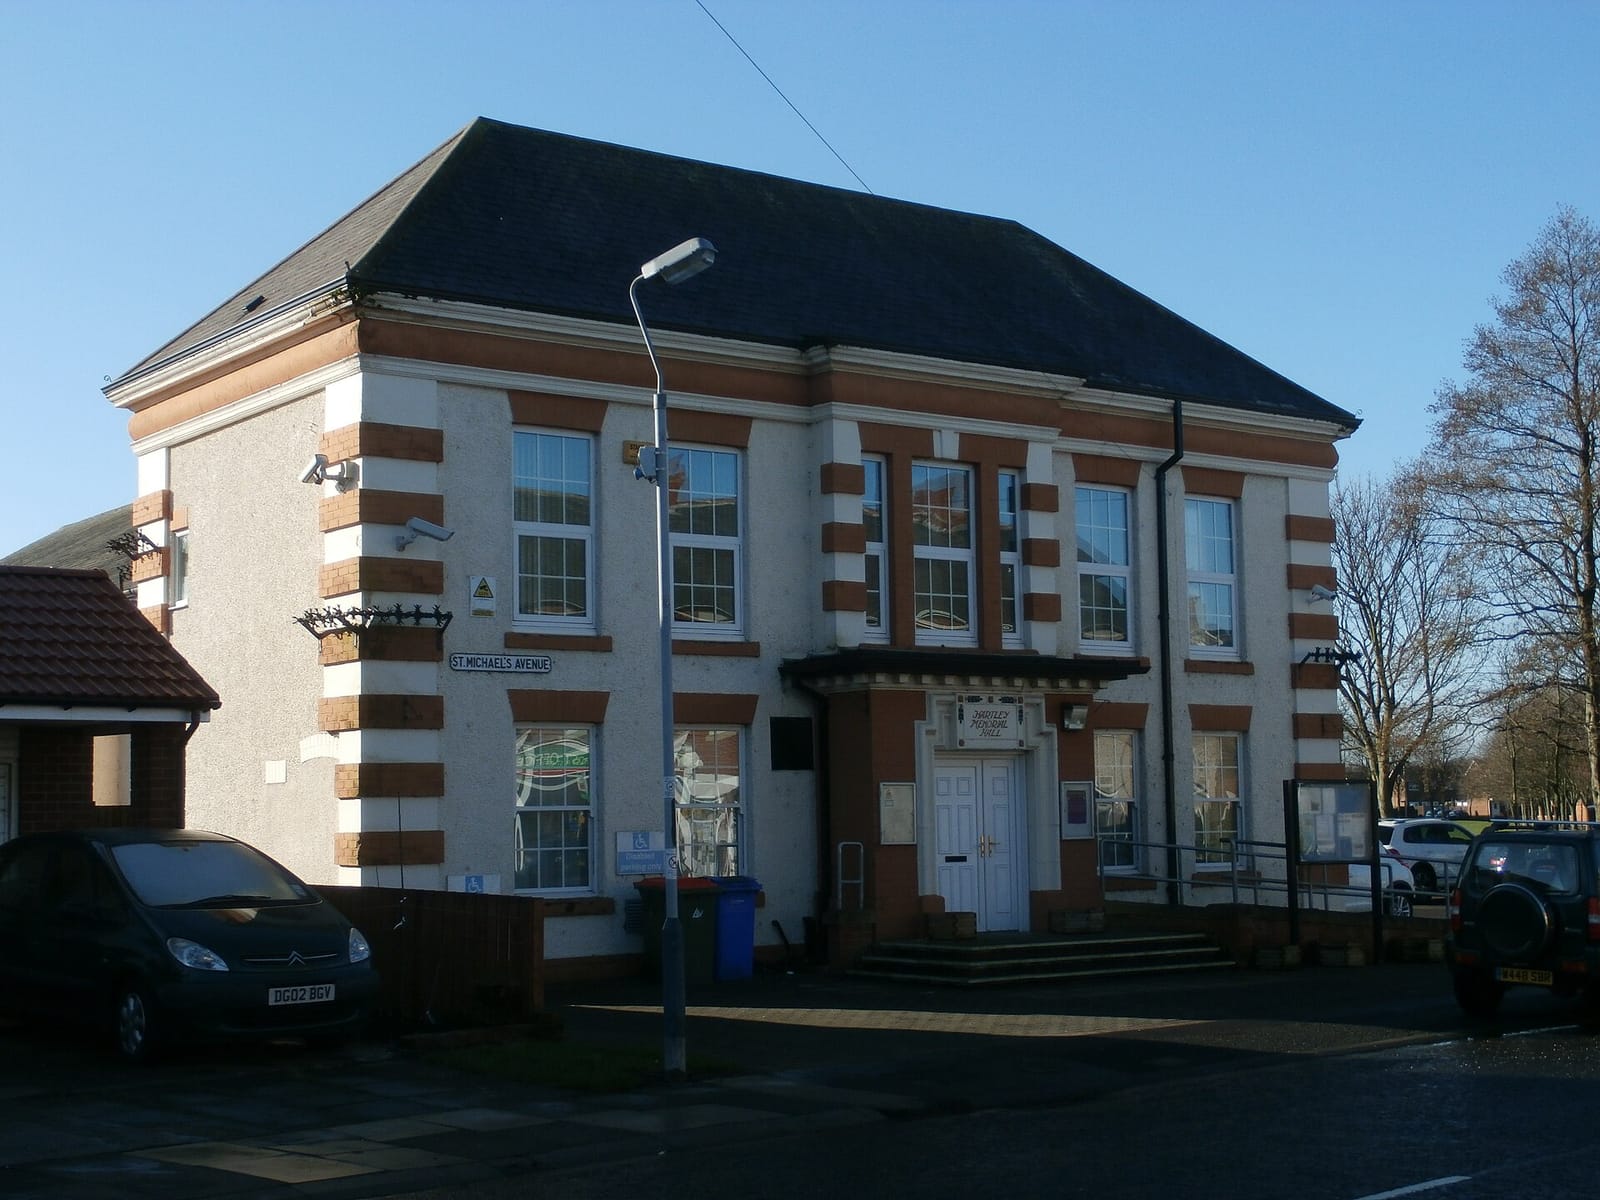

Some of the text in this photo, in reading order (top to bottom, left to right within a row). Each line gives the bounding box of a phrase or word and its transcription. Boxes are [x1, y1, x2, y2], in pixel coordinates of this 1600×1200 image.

[515, 658, 549, 670] AVENUE
[972, 710, 1010, 719] HARTLEY
[979, 728, 1001, 737] HALL
[274, 985, 331, 1003] DG02 BGV
